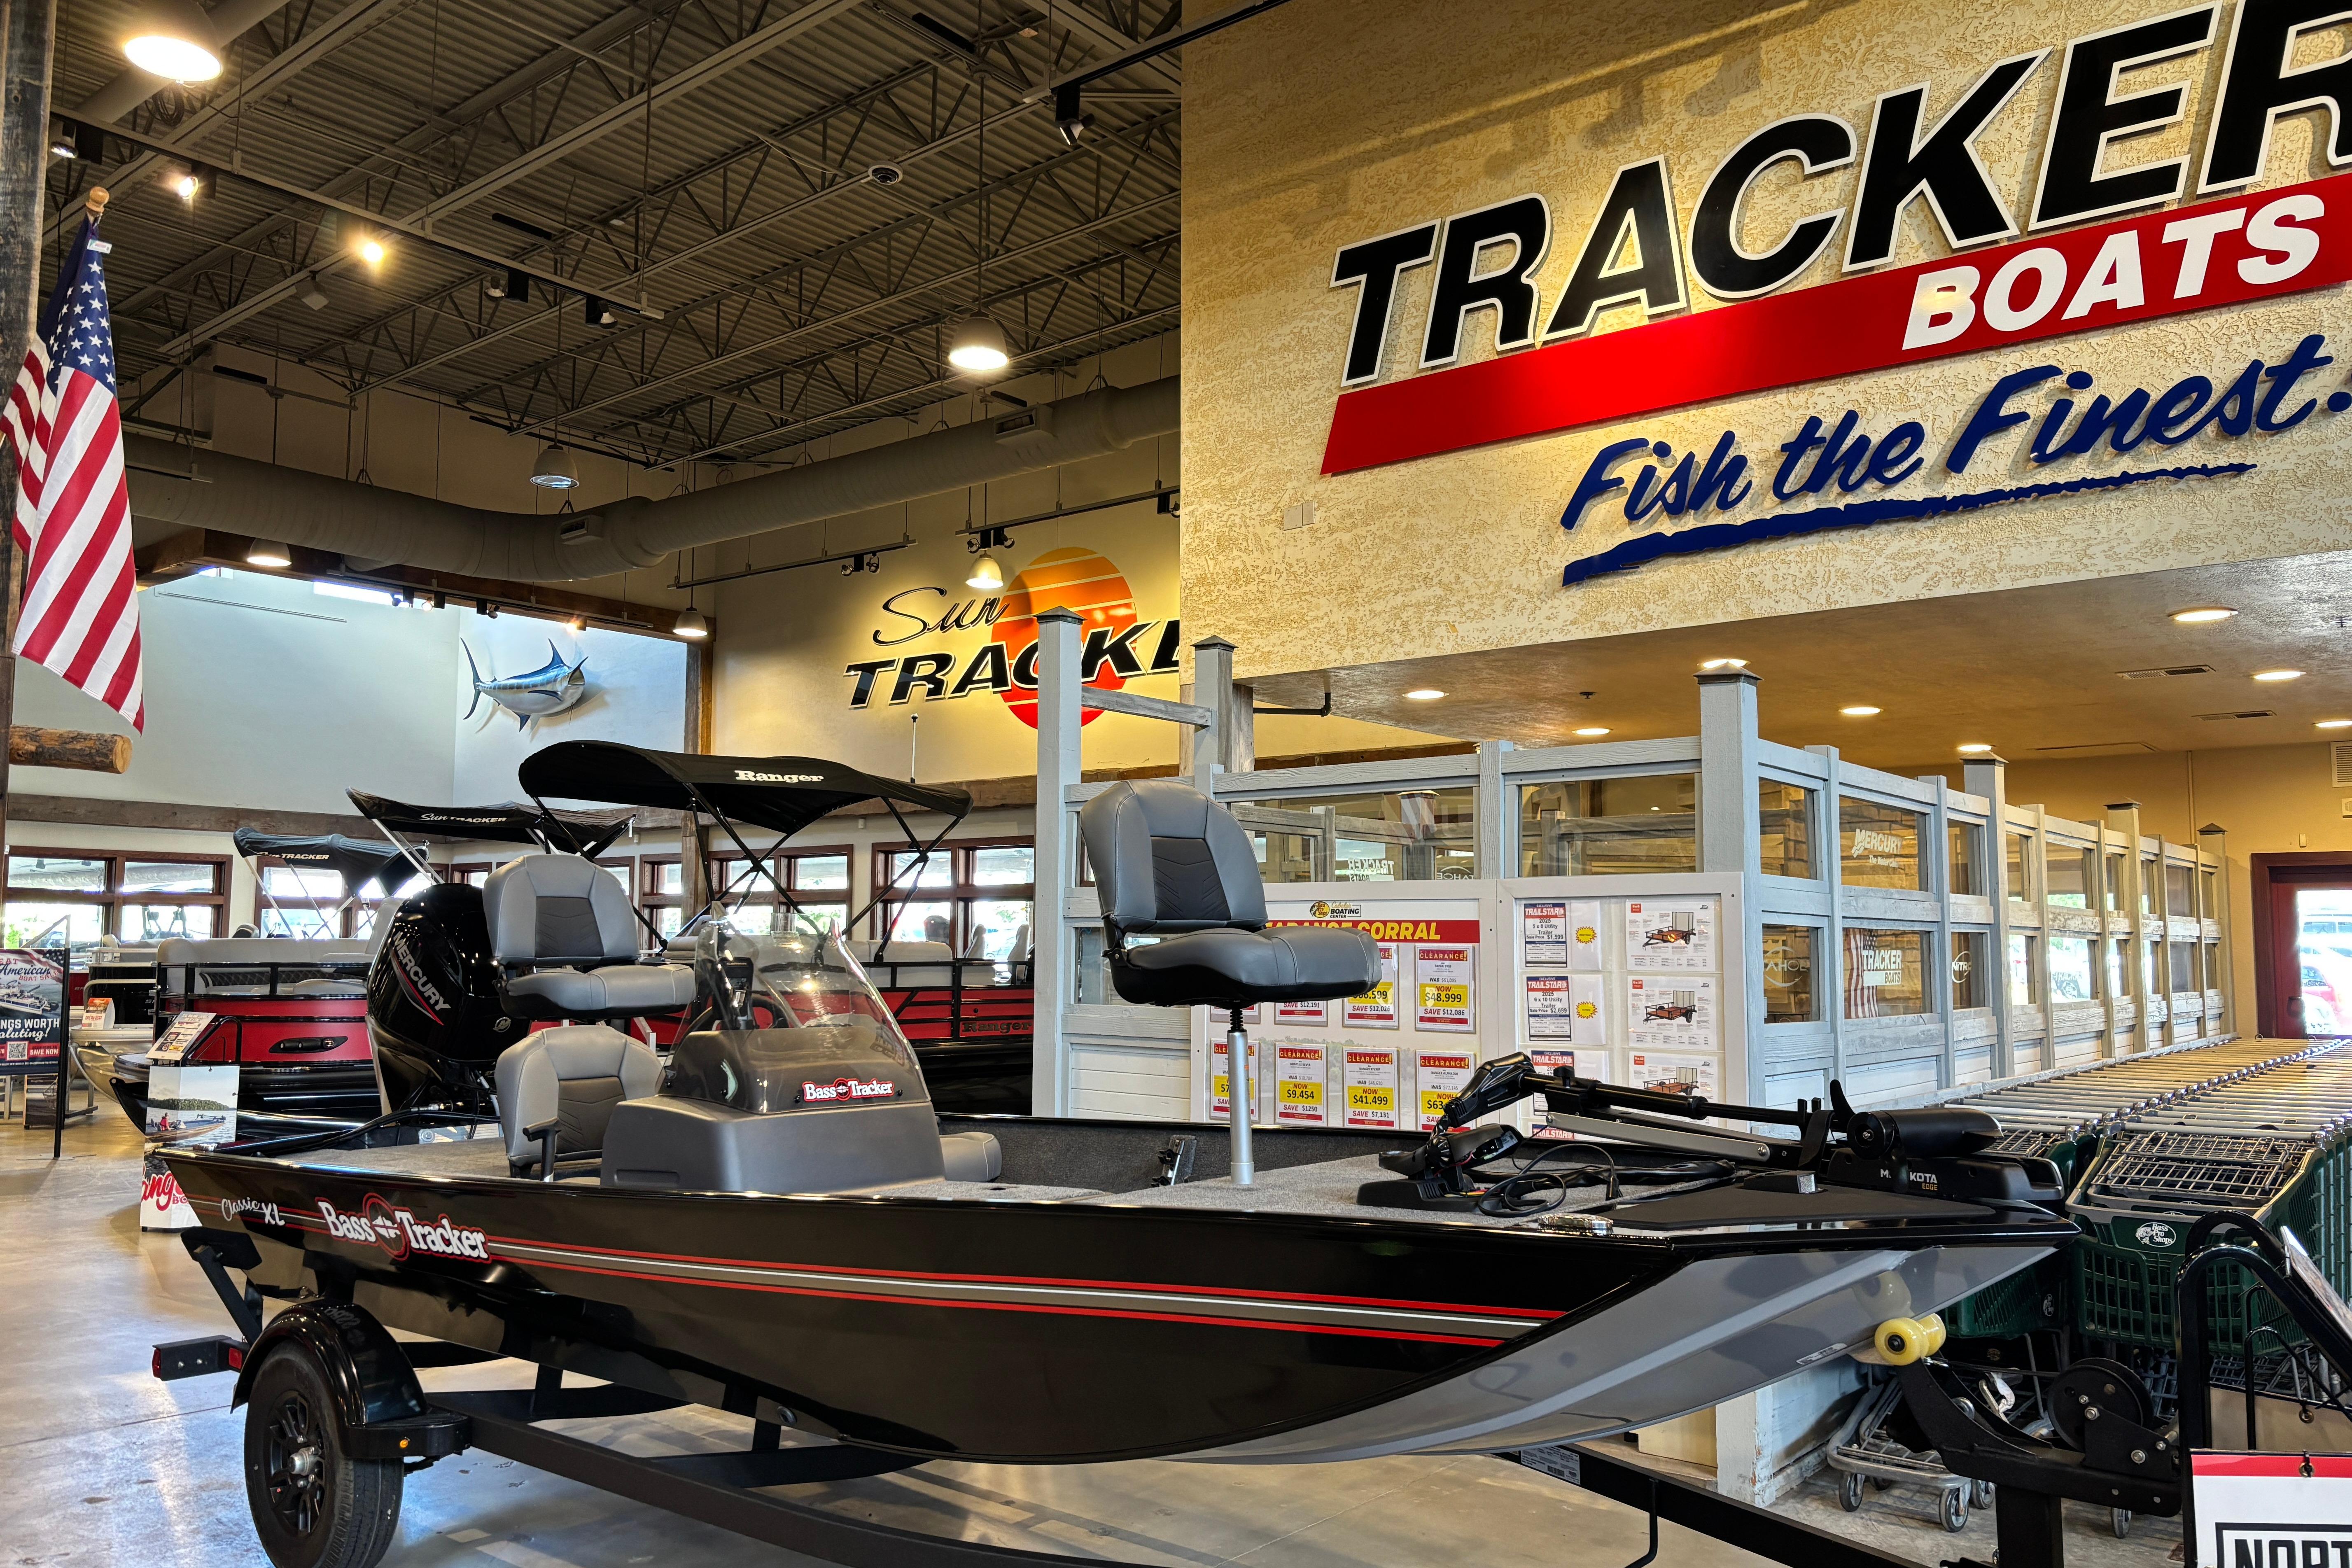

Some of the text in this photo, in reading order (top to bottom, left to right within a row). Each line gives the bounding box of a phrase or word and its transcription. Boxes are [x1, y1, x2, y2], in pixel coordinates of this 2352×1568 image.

[1330, 0, 2352, 387] TRACKER
[1902, 195, 2325, 350] BOATS
[1561, 429, 1753, 530] Fish
[1774, 409, 1924, 502] the
[873, 586, 1010, 646] Sun
[734, 770, 824, 784] Ranger
[418, 813, 448, 821] Sun
[1851, 828, 1903, 858] MERCURY
[1420, 950, 1467, 961] CLEARANCE!
[1862, 950, 1902, 970] TRACKER
[40, 970, 58, 981] SALE
[393, 931, 451, 1011] MERCURY
[1885, 972, 1900, 984] BOATS
[24, 1018, 60, 1028] WORTH
[961, 1022, 1032, 1034] Ranger
[1279, 1050, 1321, 1060] CLEARANCE!
[1347, 1054, 1392, 1064] CLEARANCE!
[1533, 1055, 1568, 1064] TRAILSTAR
[1421, 1058, 1468, 1069] CLEARANCE!
[804, 1080, 893, 1099] Bass Tracker
[1909, 1172, 1938, 1183] KOTA
[1922, 1183, 1938, 1191] EDGE
[222, 1197, 285, 1226] Classic XL
[318, 1201, 488, 1259] Bass Tracker
[2152, 1223, 2169, 1232] Bass
[2153, 1235, 2173, 1245] Shops
